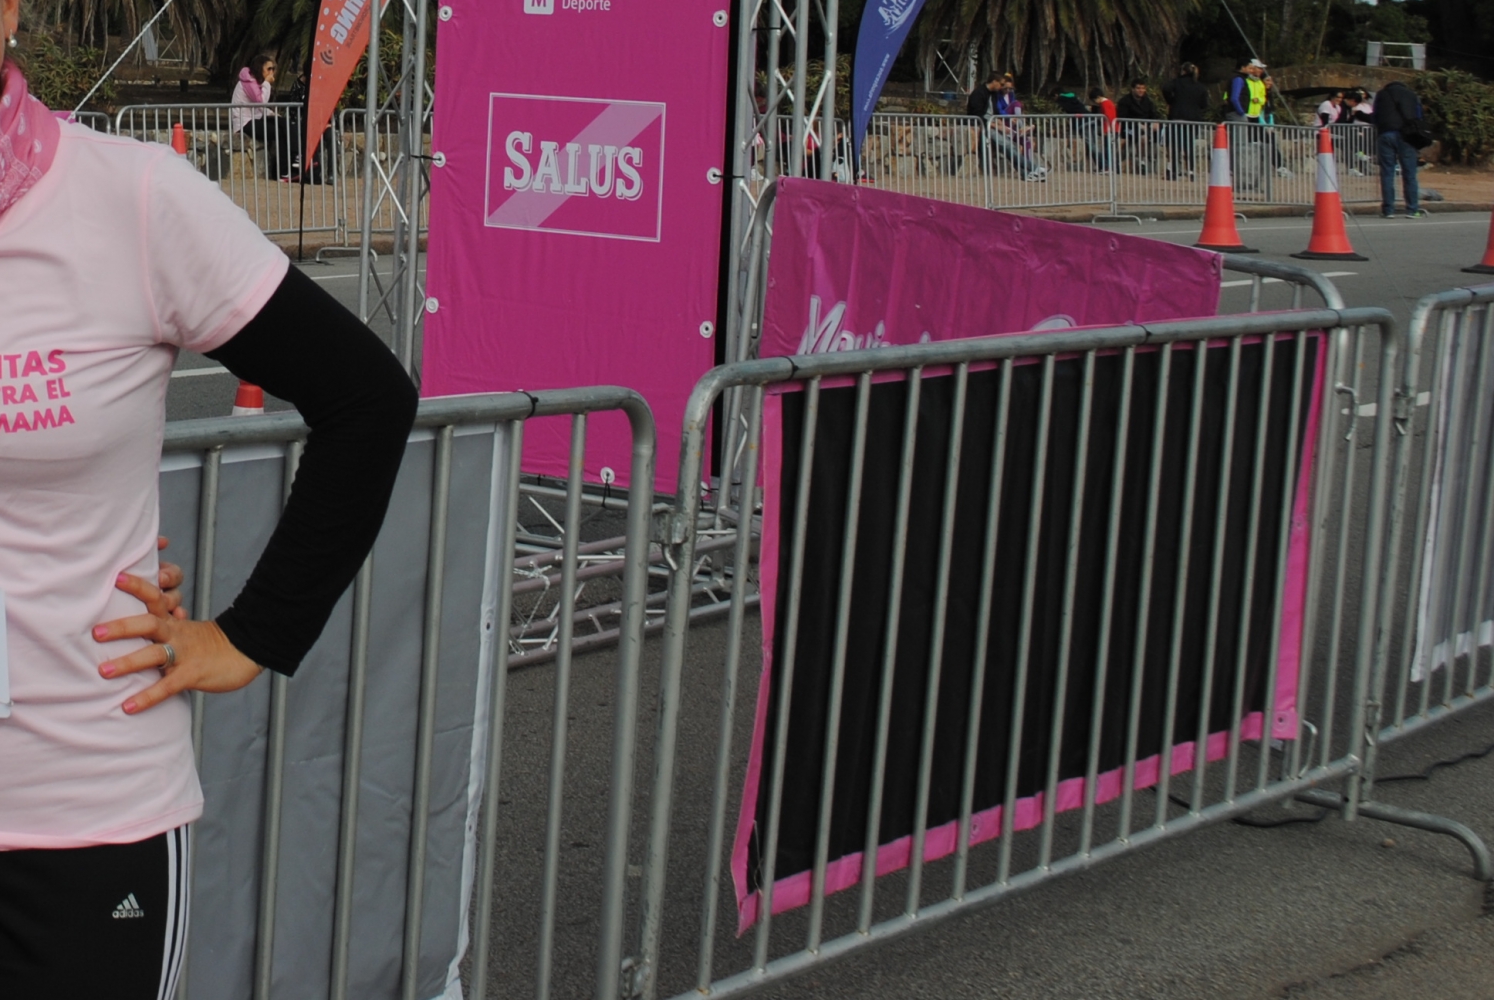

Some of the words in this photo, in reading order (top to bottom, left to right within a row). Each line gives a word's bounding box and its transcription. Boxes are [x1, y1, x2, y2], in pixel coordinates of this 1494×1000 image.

[504, 130, 644, 201] SALUS
[46, 377, 72, 400] EL
[112, 909, 145, 919] adidas
